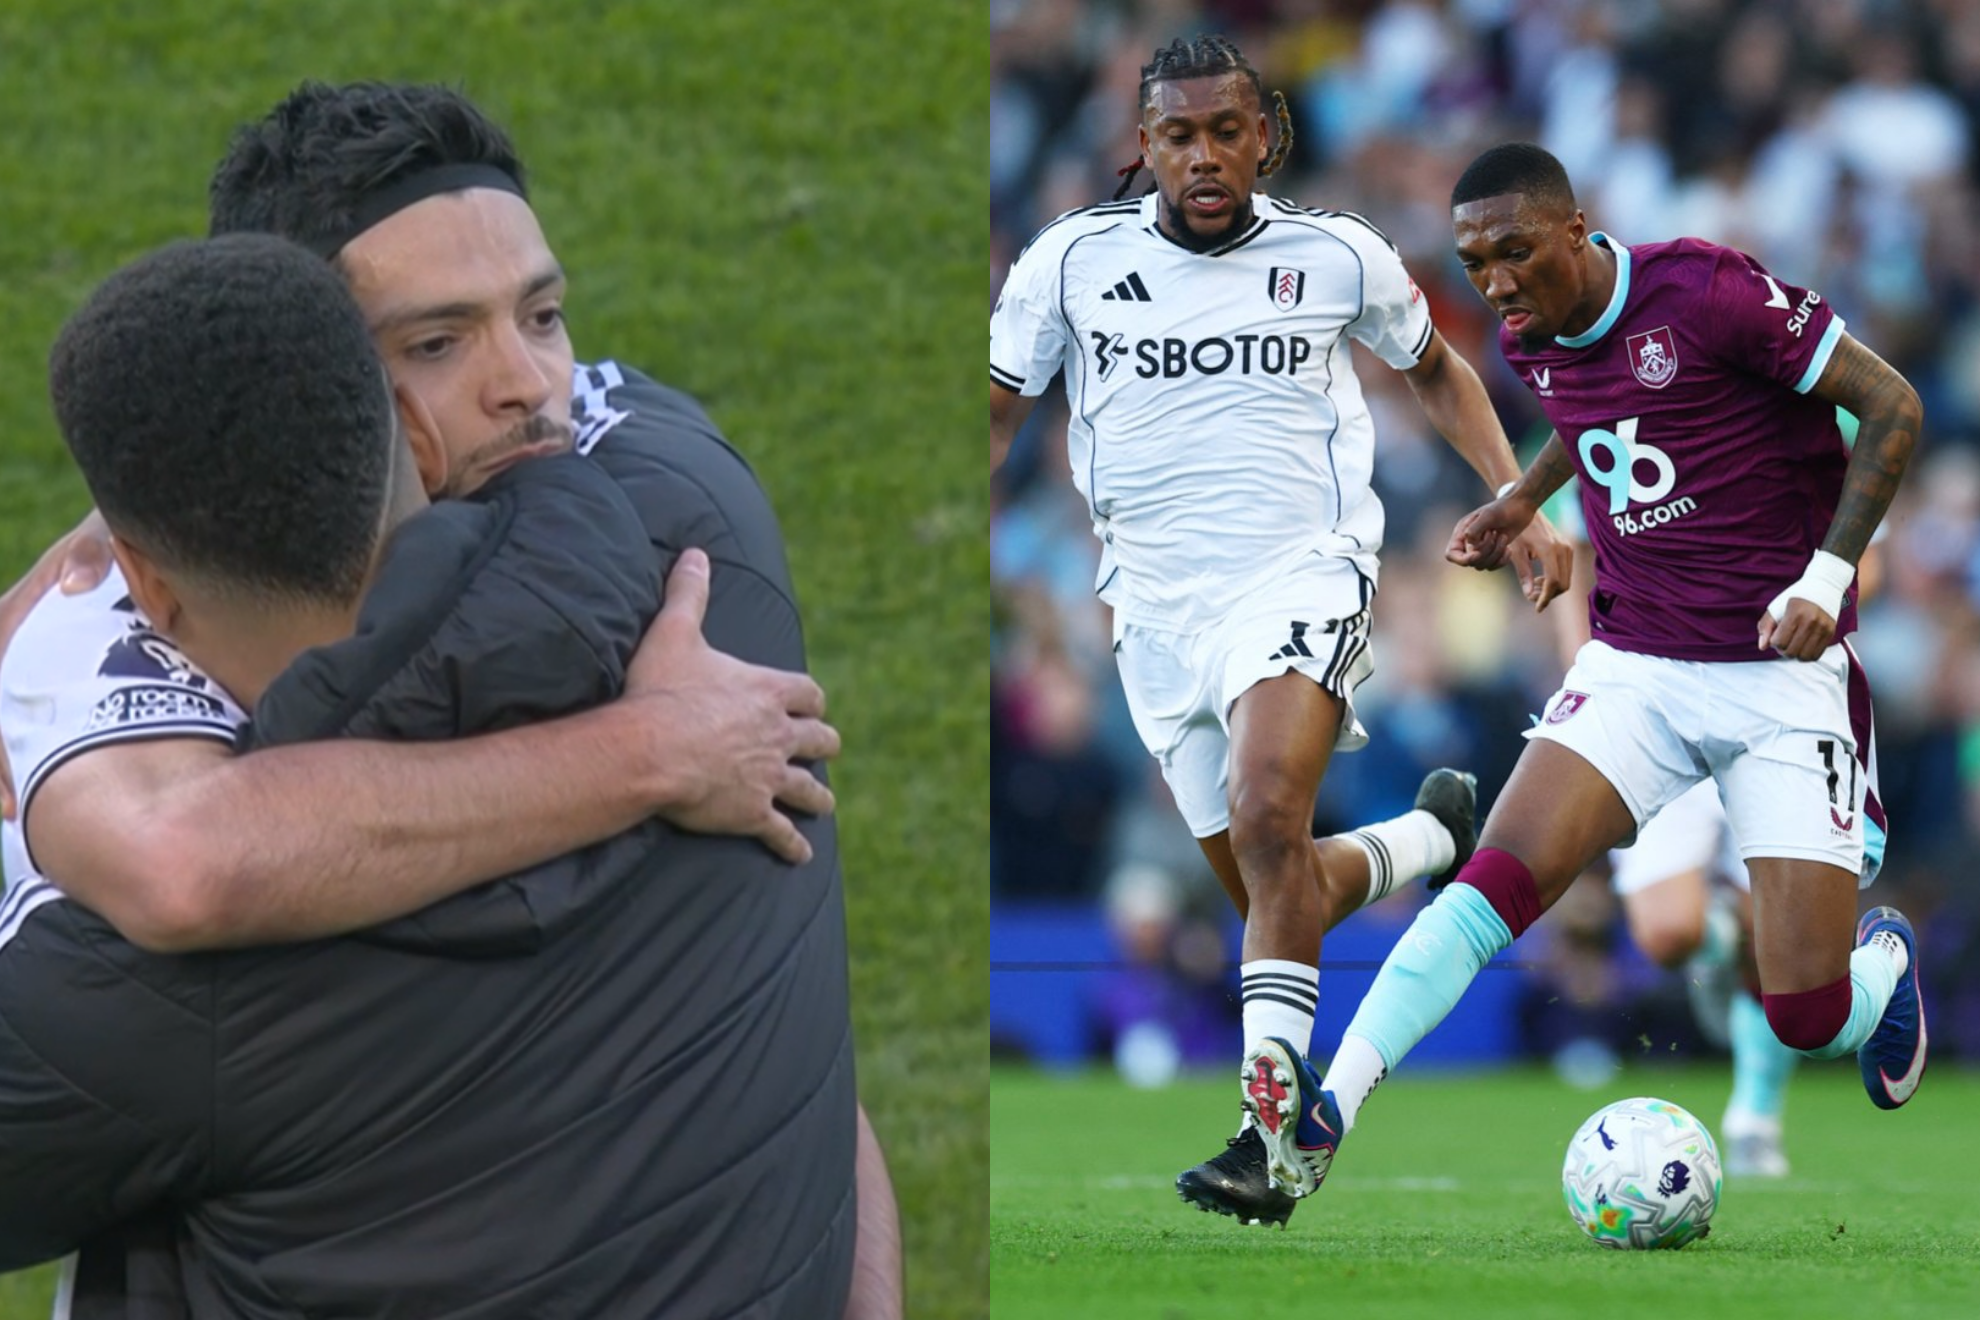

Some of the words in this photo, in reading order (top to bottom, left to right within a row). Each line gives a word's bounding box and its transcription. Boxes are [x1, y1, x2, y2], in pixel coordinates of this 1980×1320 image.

[1135, 334, 1311, 379] SBOTOP
[1577, 416, 1676, 515] 96
[1613, 496, 1697, 537] 96.com
[130, 689, 210, 712] room
[1817, 740, 1857, 812] 11
